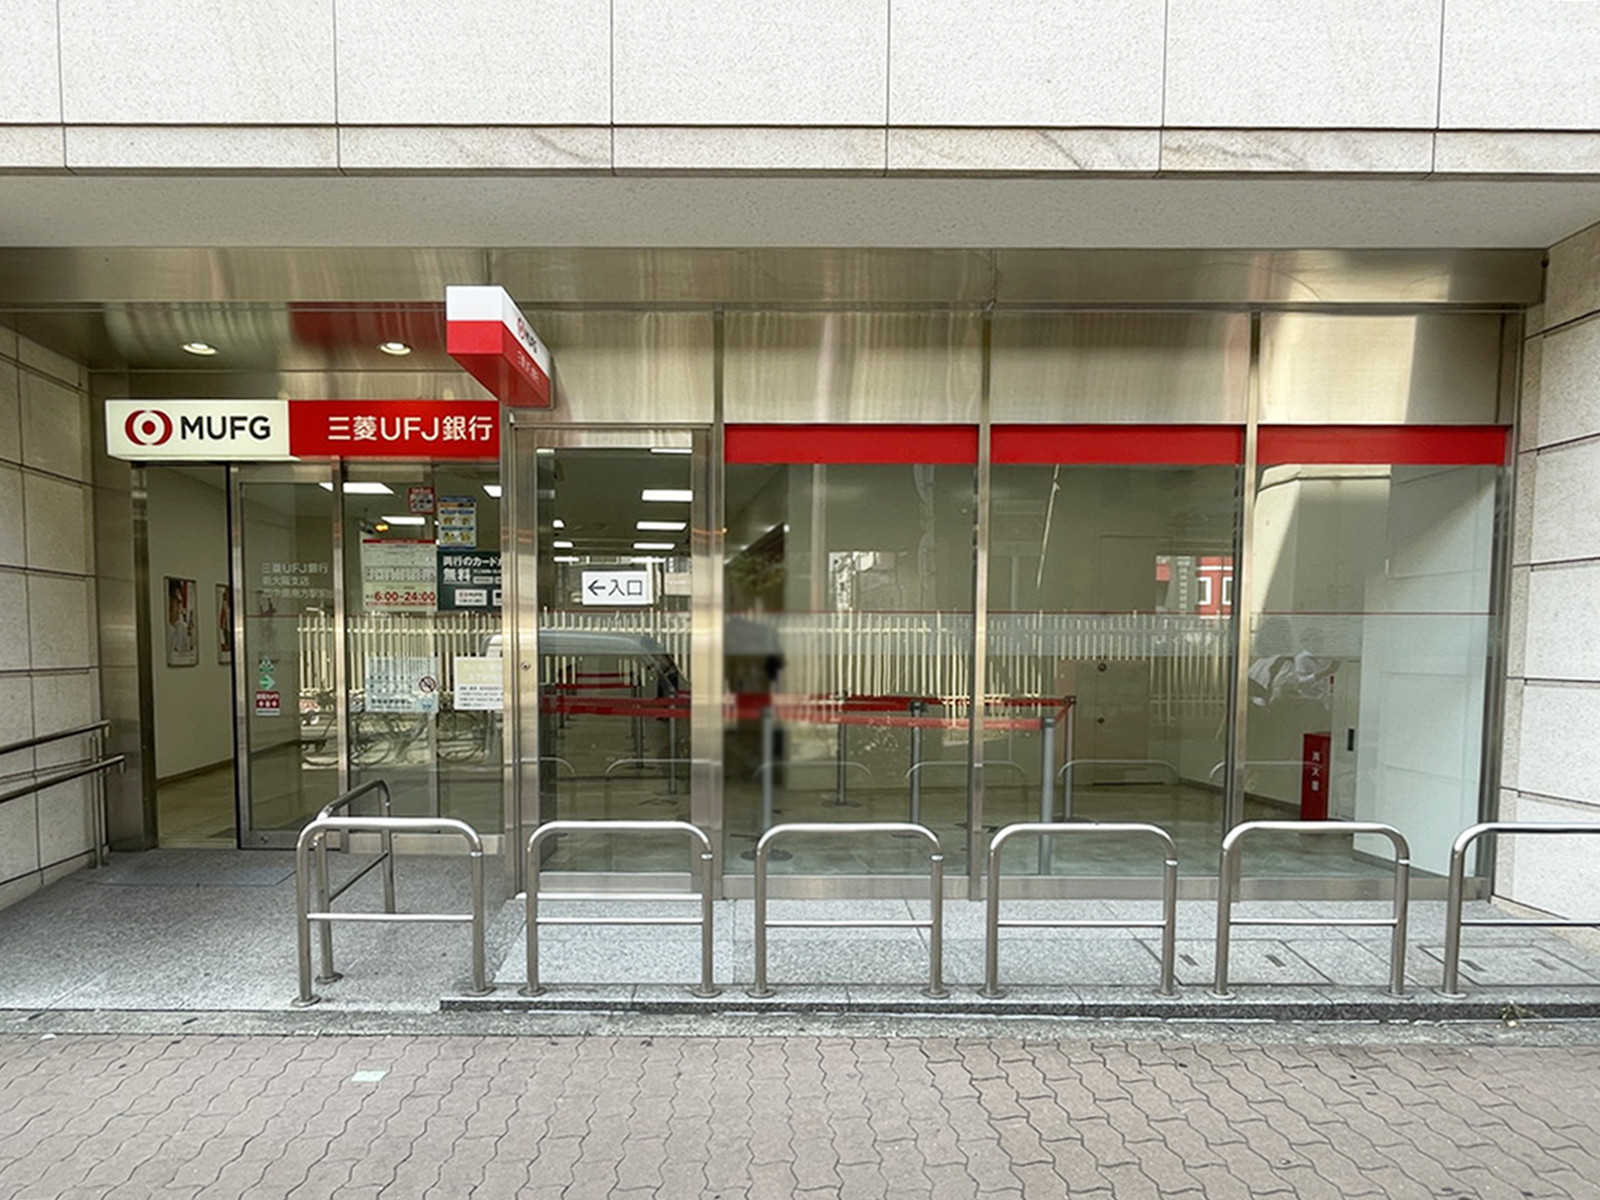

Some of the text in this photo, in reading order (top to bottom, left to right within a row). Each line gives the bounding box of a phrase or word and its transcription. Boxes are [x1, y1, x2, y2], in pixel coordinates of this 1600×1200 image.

[180, 415, 271, 441] MUFG
[328, 415, 493, 441] 三菱UFJ銀行
[608, 579, 643, 596] 入口
